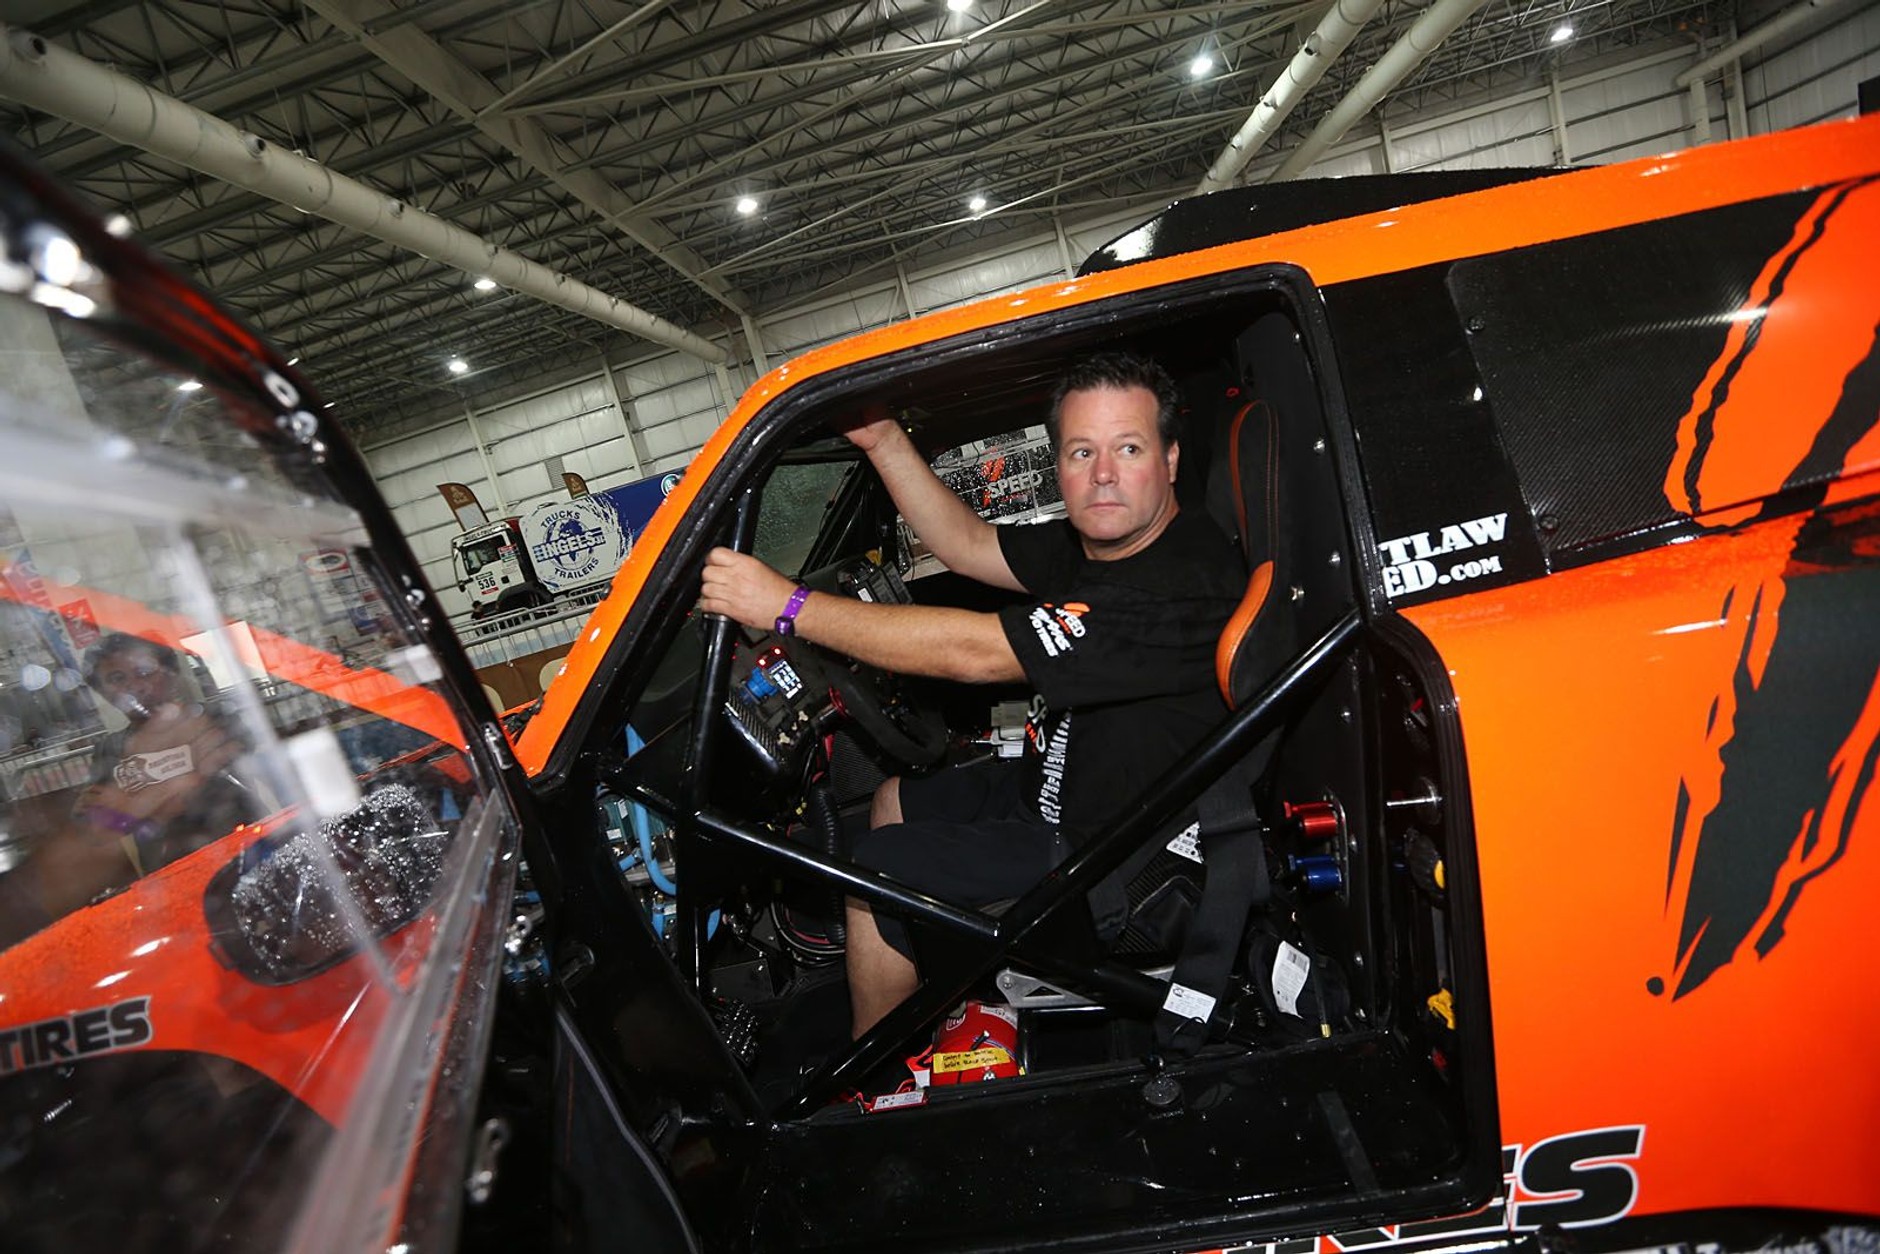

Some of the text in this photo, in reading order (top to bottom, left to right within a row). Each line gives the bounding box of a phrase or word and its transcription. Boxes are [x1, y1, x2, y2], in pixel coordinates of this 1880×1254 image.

[986, 471, 1044, 499] SPEED
[540, 510, 581, 528] TRUCKS
[554, 557, 599, 579] TRAILERS
[478, 577, 496, 590] 536
[0, 995, 153, 1075] TIRES
